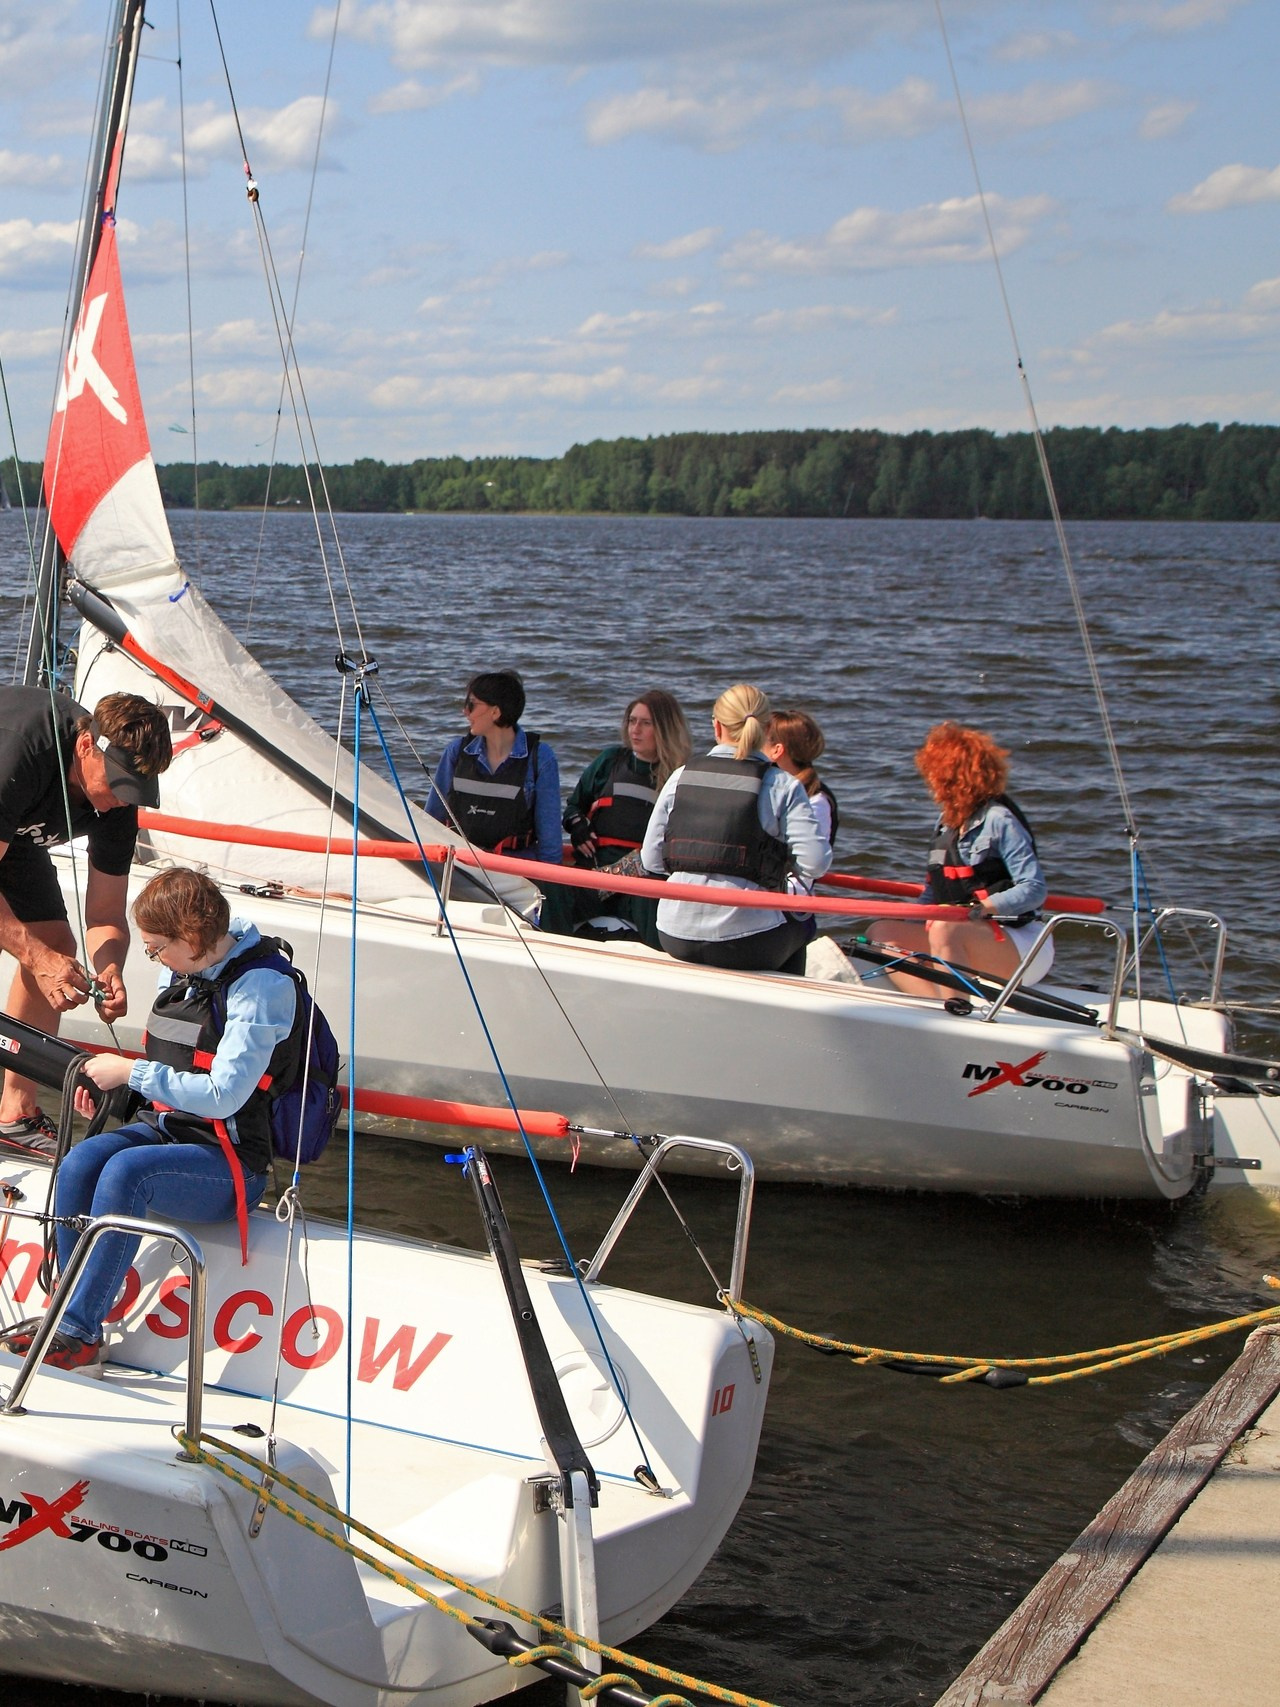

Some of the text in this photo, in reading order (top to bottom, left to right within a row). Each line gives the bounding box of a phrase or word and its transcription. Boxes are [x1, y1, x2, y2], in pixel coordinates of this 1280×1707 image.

[1054, 1102, 1110, 1113] CARBON
[712, 1384, 736, 1416] 10
[70, 1515, 169, 1546] SAILING BOATS
[126, 1573, 208, 1599] CARBON
